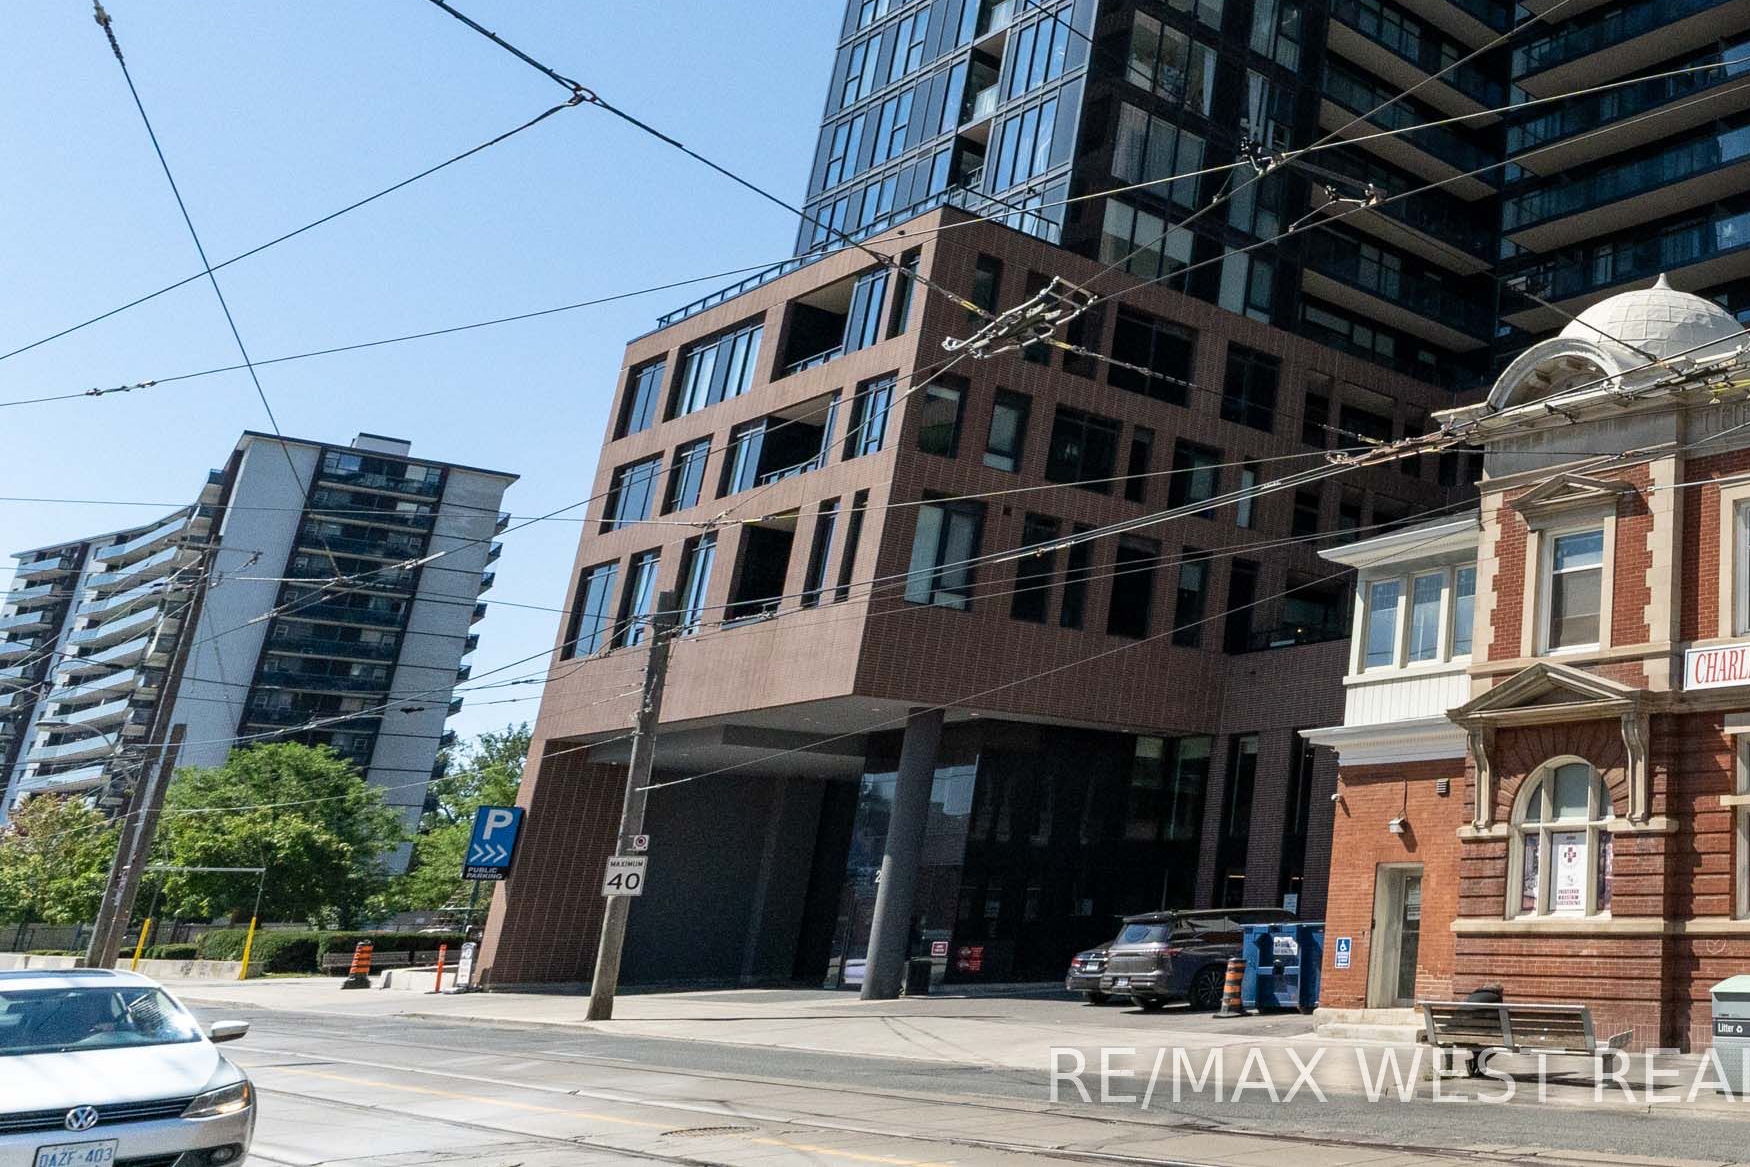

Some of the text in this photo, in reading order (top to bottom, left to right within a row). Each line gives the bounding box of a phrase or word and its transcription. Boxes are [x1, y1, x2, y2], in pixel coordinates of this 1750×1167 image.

[482, 809, 514, 840] P
[610, 859, 644, 867] MAXIMUM
[607, 872, 640, 890] 40
[1717, 1023, 1734, 1033] Litter
[85, 1147, 112, 1163] 403
